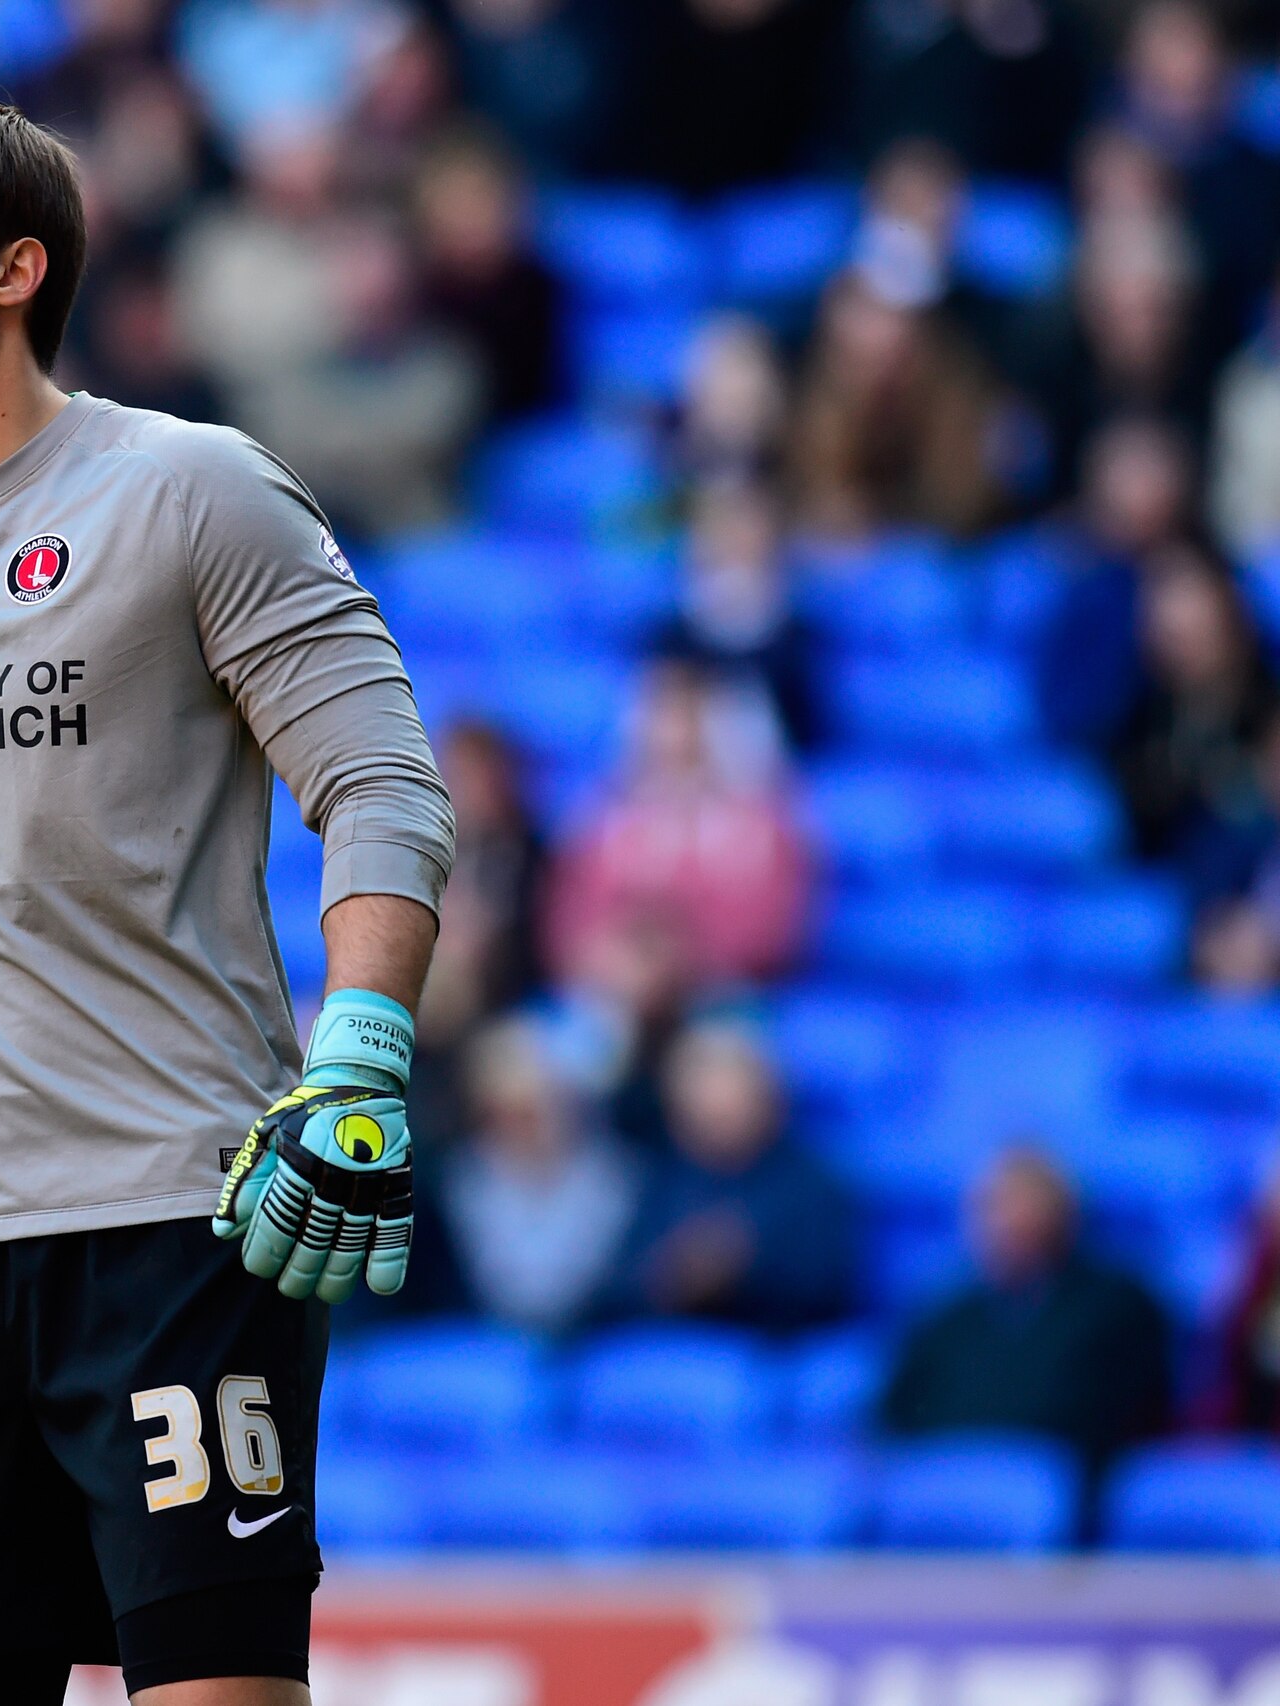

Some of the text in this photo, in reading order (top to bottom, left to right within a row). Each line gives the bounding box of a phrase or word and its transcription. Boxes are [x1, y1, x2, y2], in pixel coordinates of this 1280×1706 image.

[19, 538, 63, 557] CHARLTON
[15, 585, 53, 601] ATHLETIC
[27, 660, 85, 695] OF
[348, 1018, 411, 1047] mitrovic
[360, 1036, 407, 1063] Marko
[130, 1374, 284, 1513] 36
